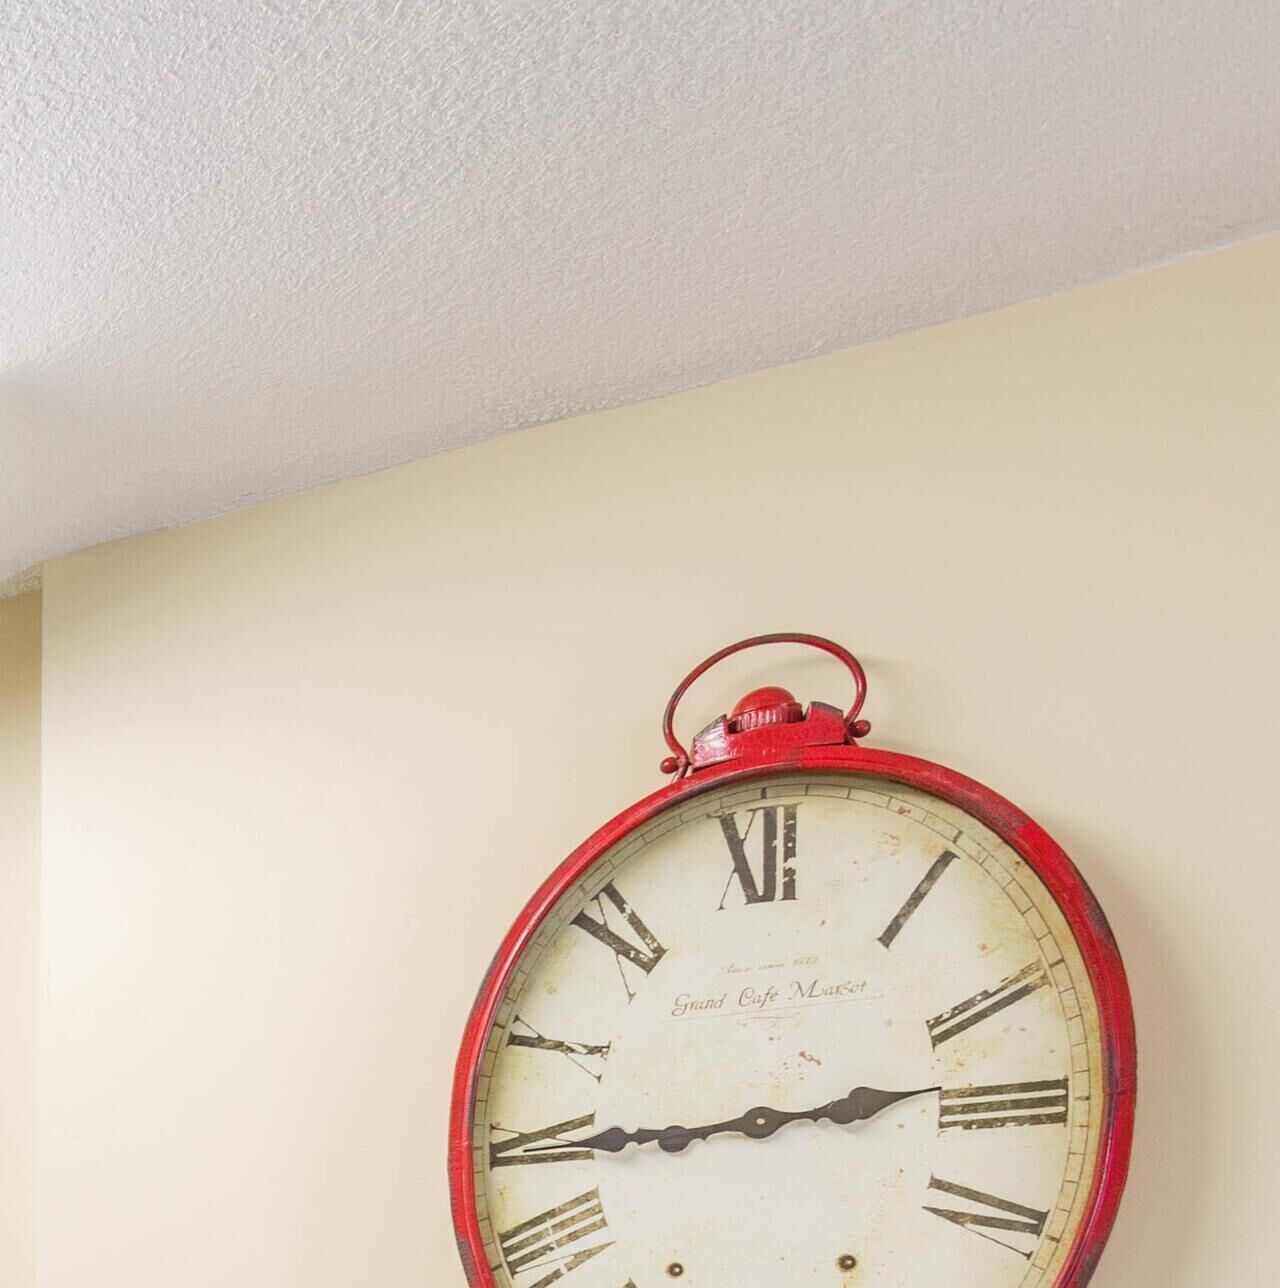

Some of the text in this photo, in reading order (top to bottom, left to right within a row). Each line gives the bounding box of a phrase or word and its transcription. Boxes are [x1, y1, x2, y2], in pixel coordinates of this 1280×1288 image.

[706, 802, 802, 911] XII
[569, 877, 669, 1004] XI
[671, 993, 727, 1017] Grand
[937, 1075, 1069, 1138] III
